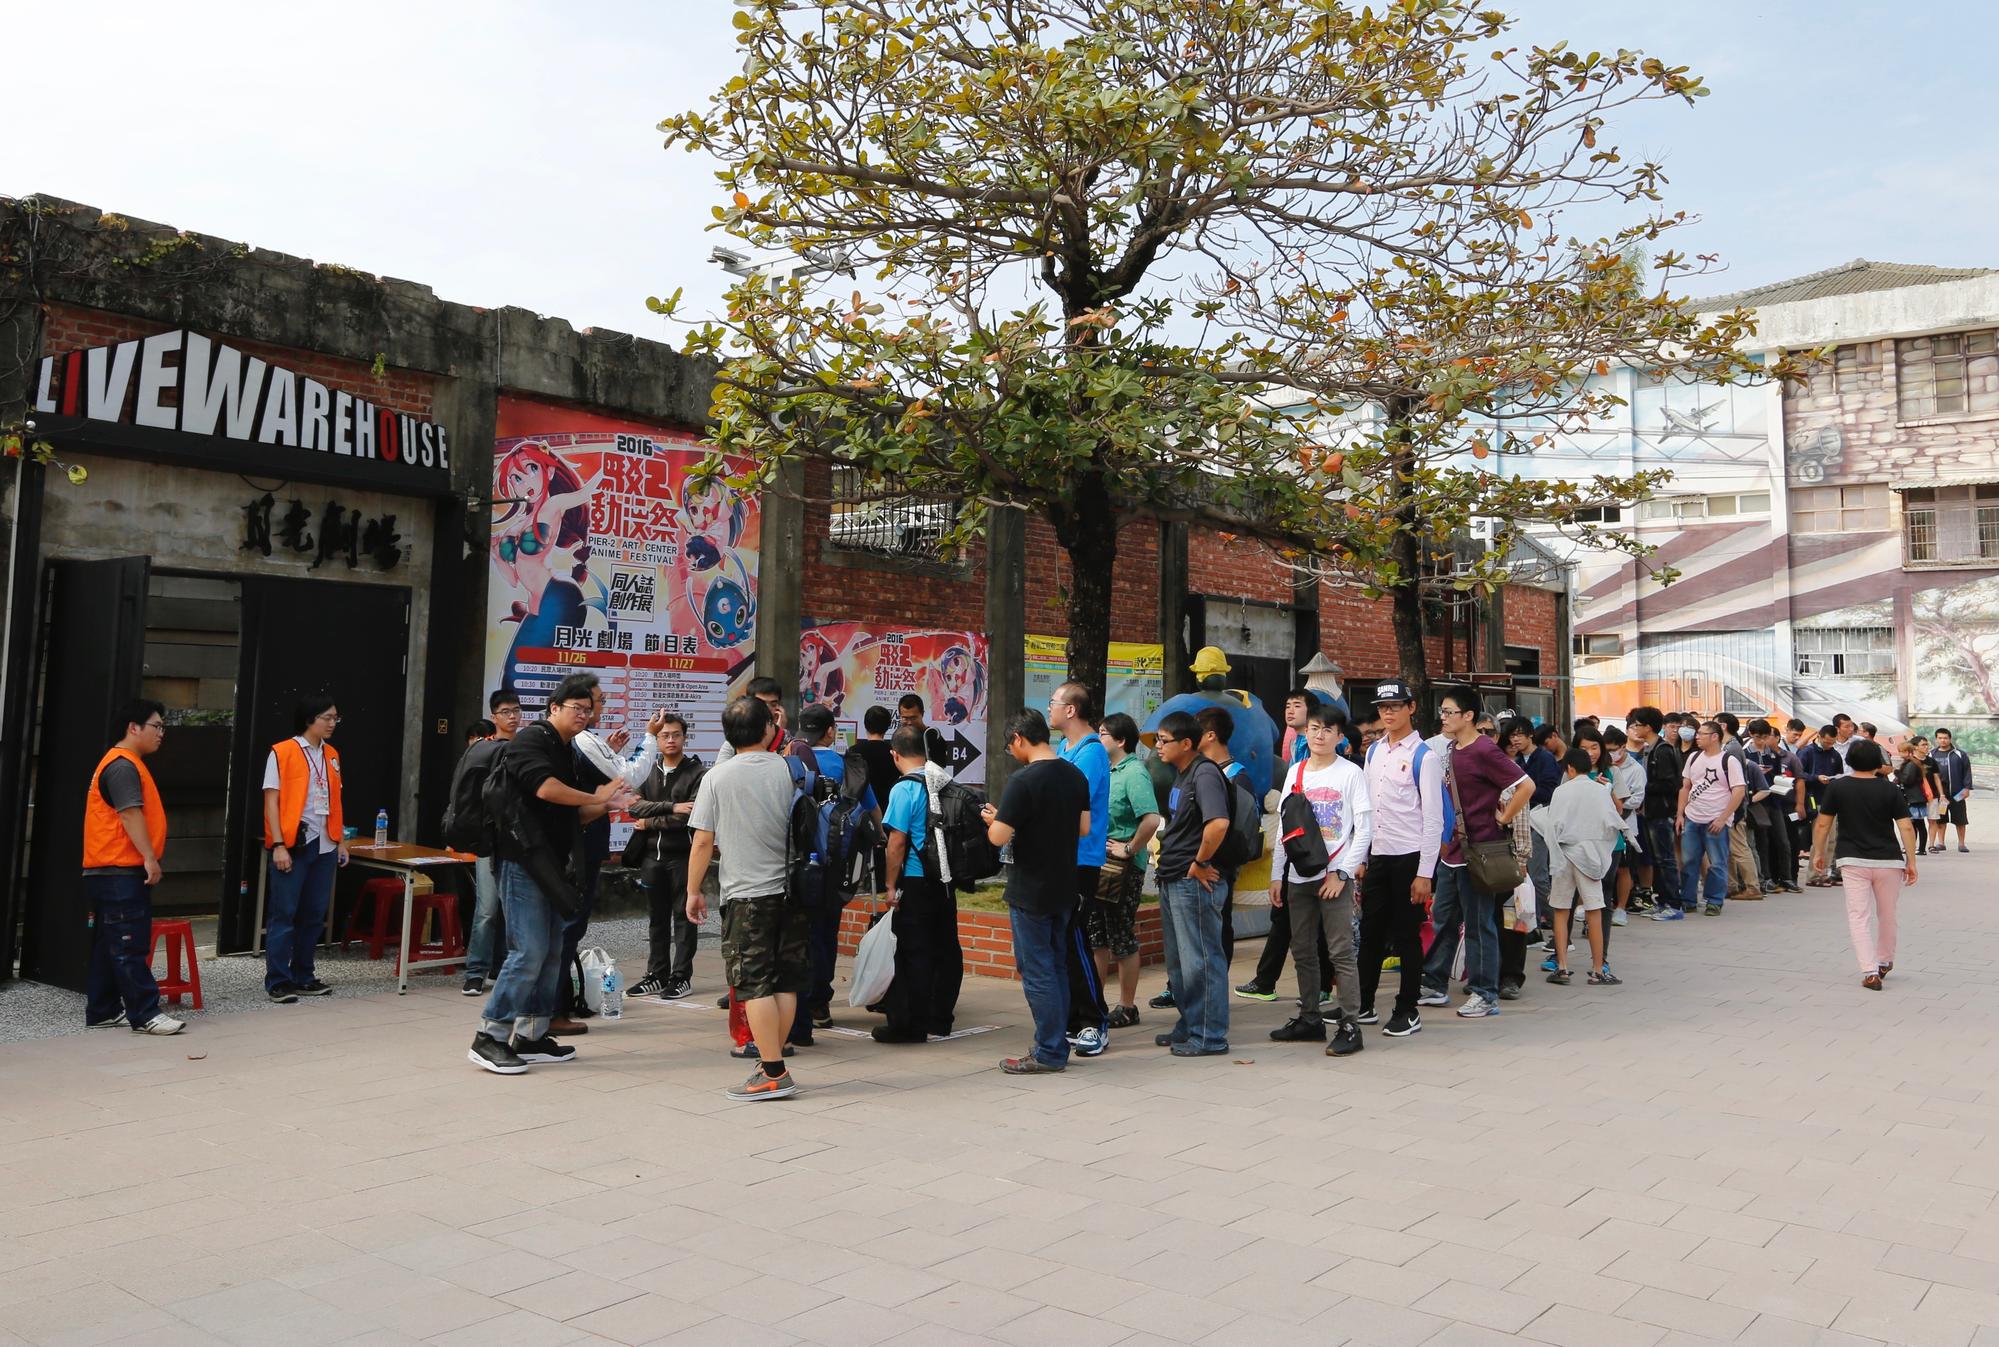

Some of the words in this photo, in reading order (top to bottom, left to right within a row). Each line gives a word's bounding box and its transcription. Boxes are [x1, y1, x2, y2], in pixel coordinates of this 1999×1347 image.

[617, 435, 653, 456] 2016
[588, 536, 616, 548] PIER-2
[622, 541, 639, 550] ART
[645, 543, 677, 555] CENTER
[590, 548, 621, 559] ANIME
[630, 551, 674, 565] FESTIVAL
[610, 572, 655, 594] 同人誌
[608, 591, 654, 613] 創作展
[555, 626, 633, 651] 月光劇場
[644, 633, 697, 655] 節目表
[886, 633, 904, 644] 2016
[558, 651, 587, 664] 11/26
[668, 658, 695, 670] 11/27
[952, 747, 968, 760] B4
